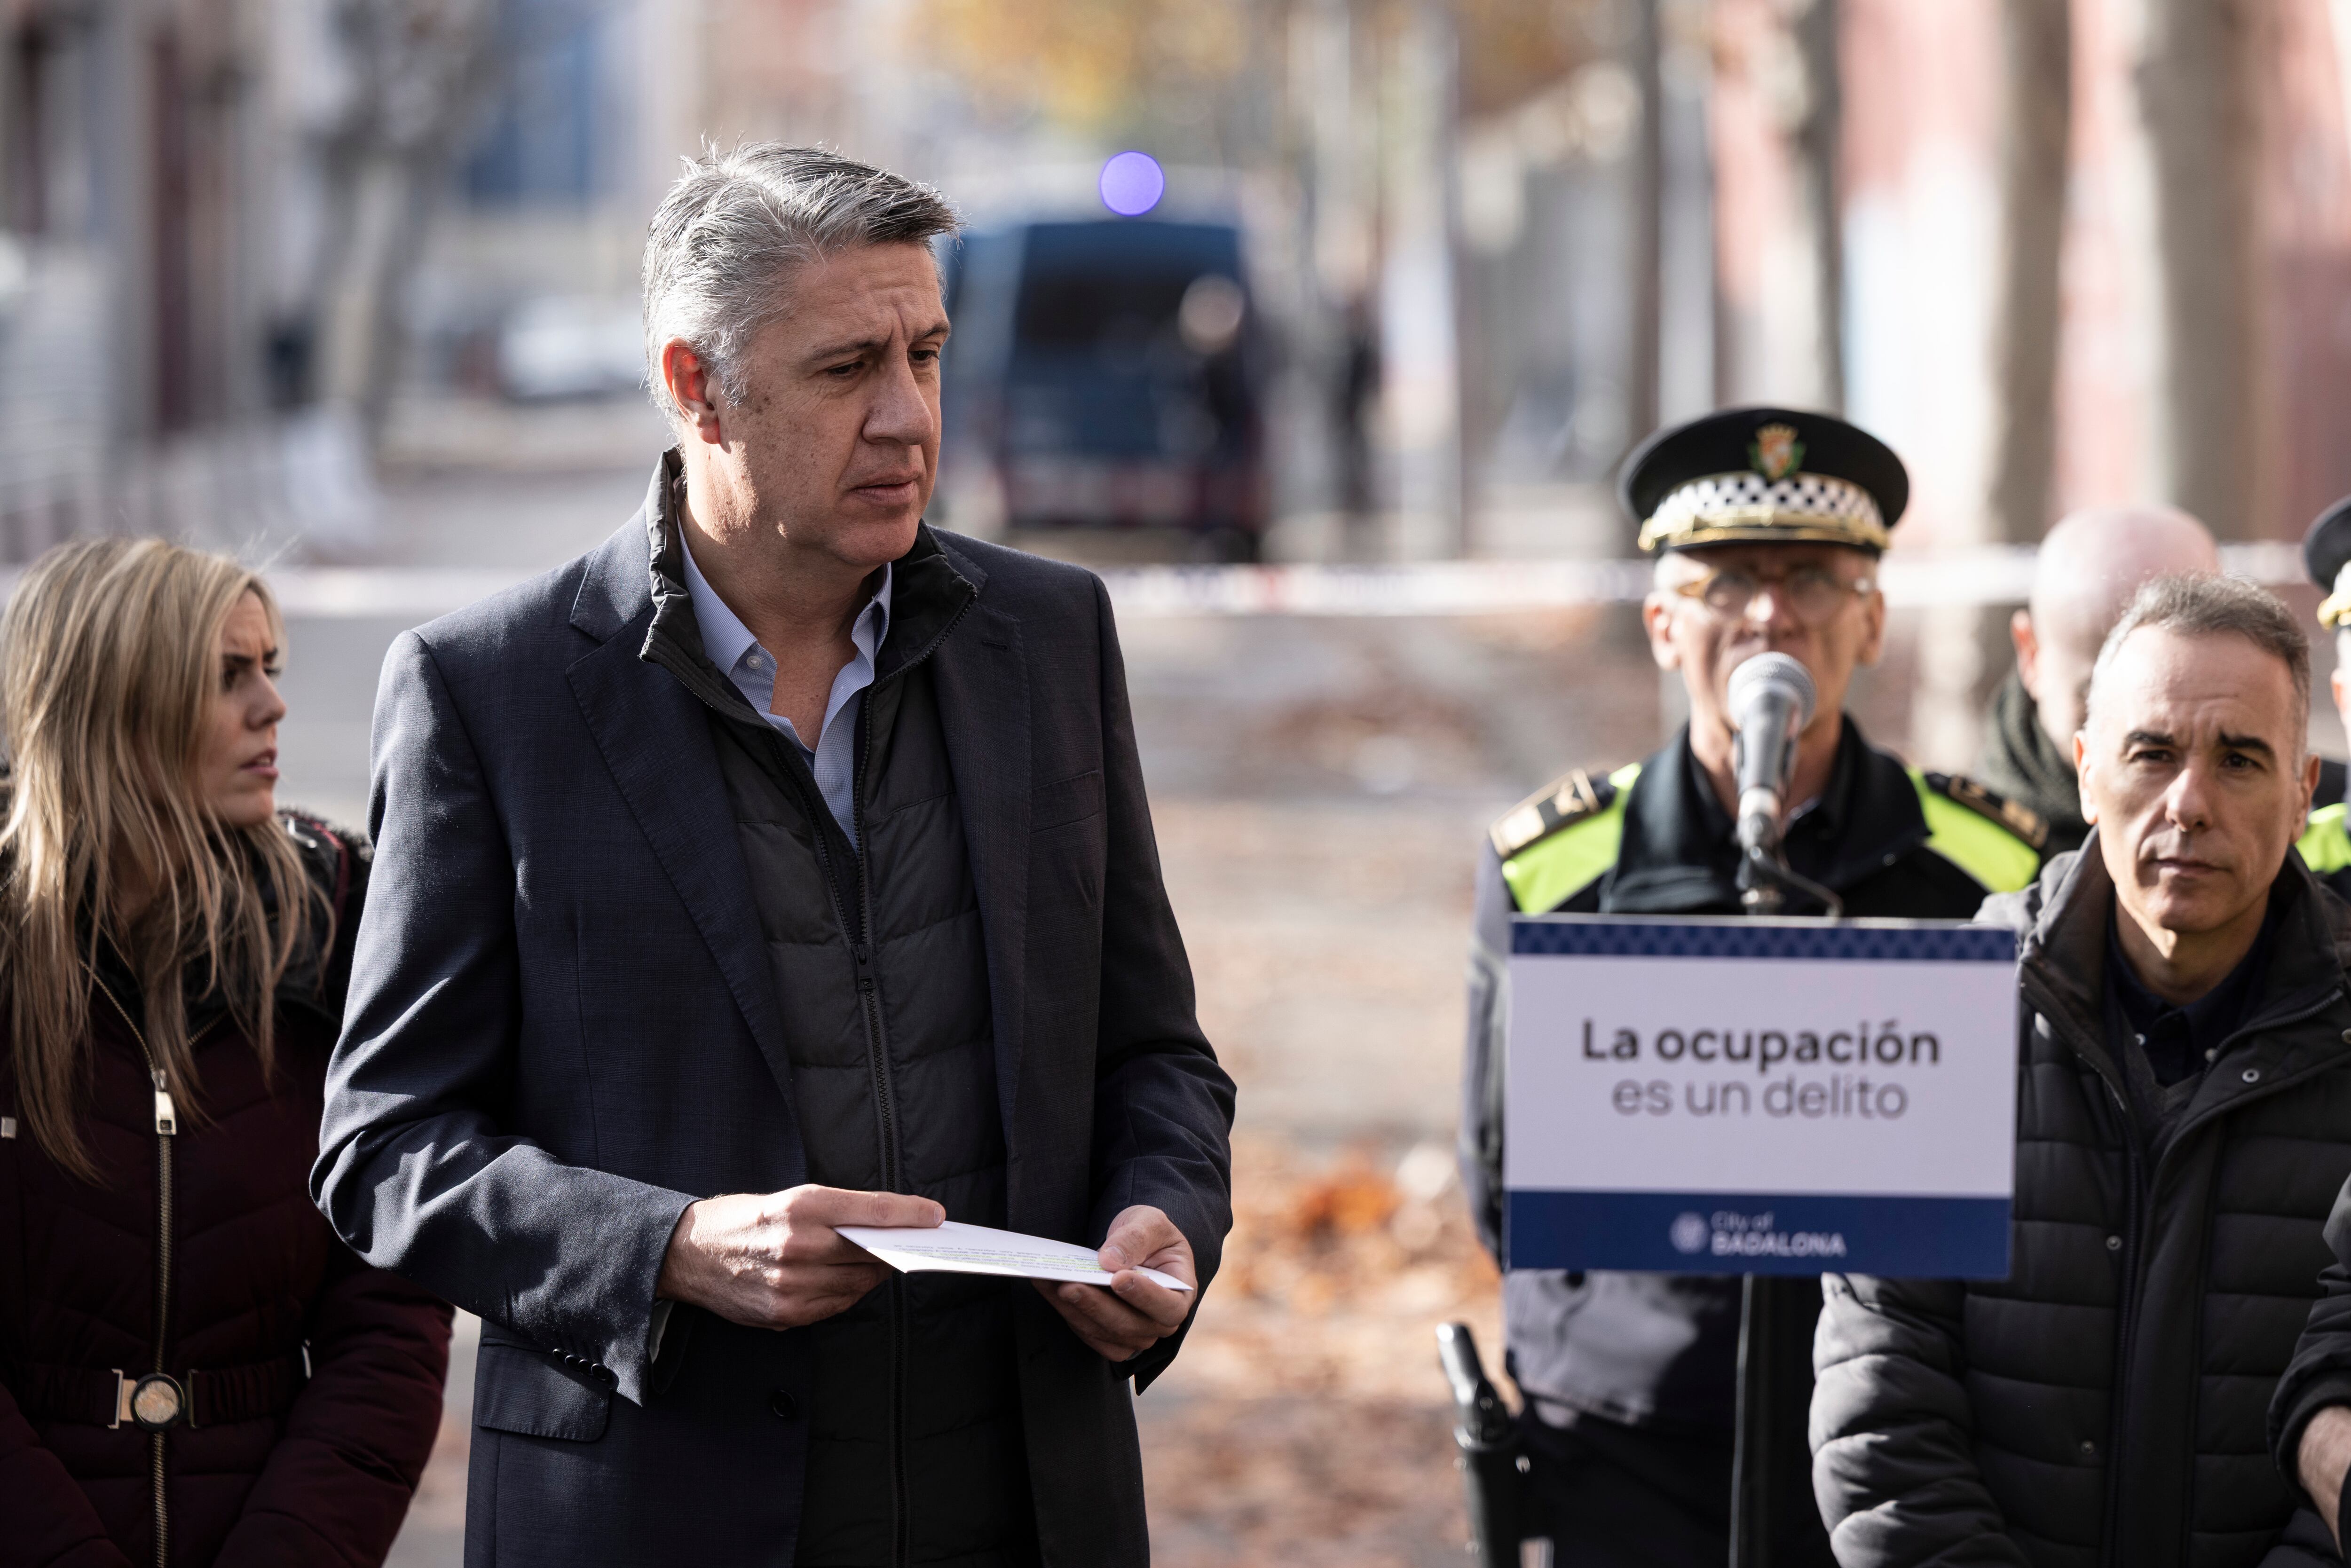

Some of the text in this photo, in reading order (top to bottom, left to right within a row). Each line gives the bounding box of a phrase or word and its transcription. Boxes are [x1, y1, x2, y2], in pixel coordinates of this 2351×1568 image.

[1582, 1018, 1940, 1074] La ocupación
[1612, 1075, 1909, 1119] es un delito
[1712, 1231, 1846, 1257] BADALONA
